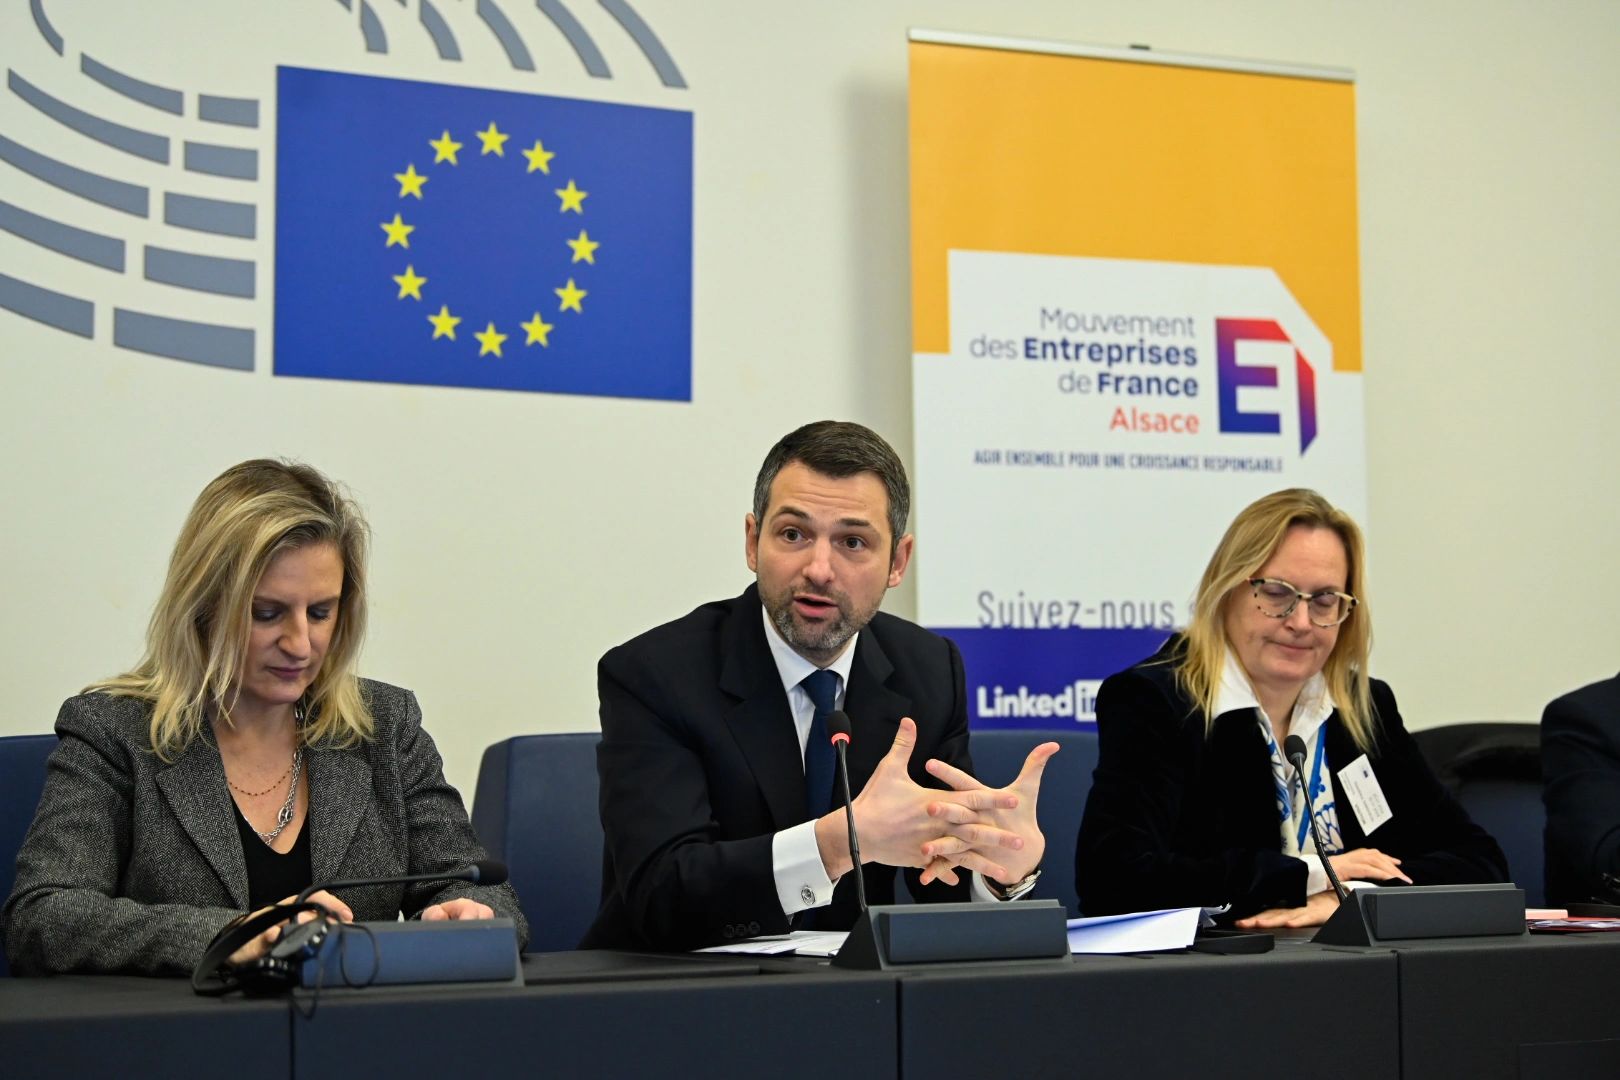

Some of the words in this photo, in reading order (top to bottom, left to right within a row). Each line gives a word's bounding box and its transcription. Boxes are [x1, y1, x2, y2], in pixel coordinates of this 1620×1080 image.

[1041, 307, 1195, 338] Mouvement
[970, 334, 1018, 359] des
[1024, 337, 1198, 367] Entreprises
[1058, 370, 1091, 393] de
[1097, 372, 1198, 397] France
[1110, 406, 1199, 434] Alsace
[974, 449, 1000, 465] AGIR
[1005, 450, 1064, 467] ENSEMBLE
[1069, 452, 1099, 468] POUR
[1104, 453, 1125, 469] UNE
[1130, 454, 1199, 470] CROISSANCE
[1203, 456, 1282, 473] RESPONSABLE
[977, 590, 1175, 629] Suivez-nous
